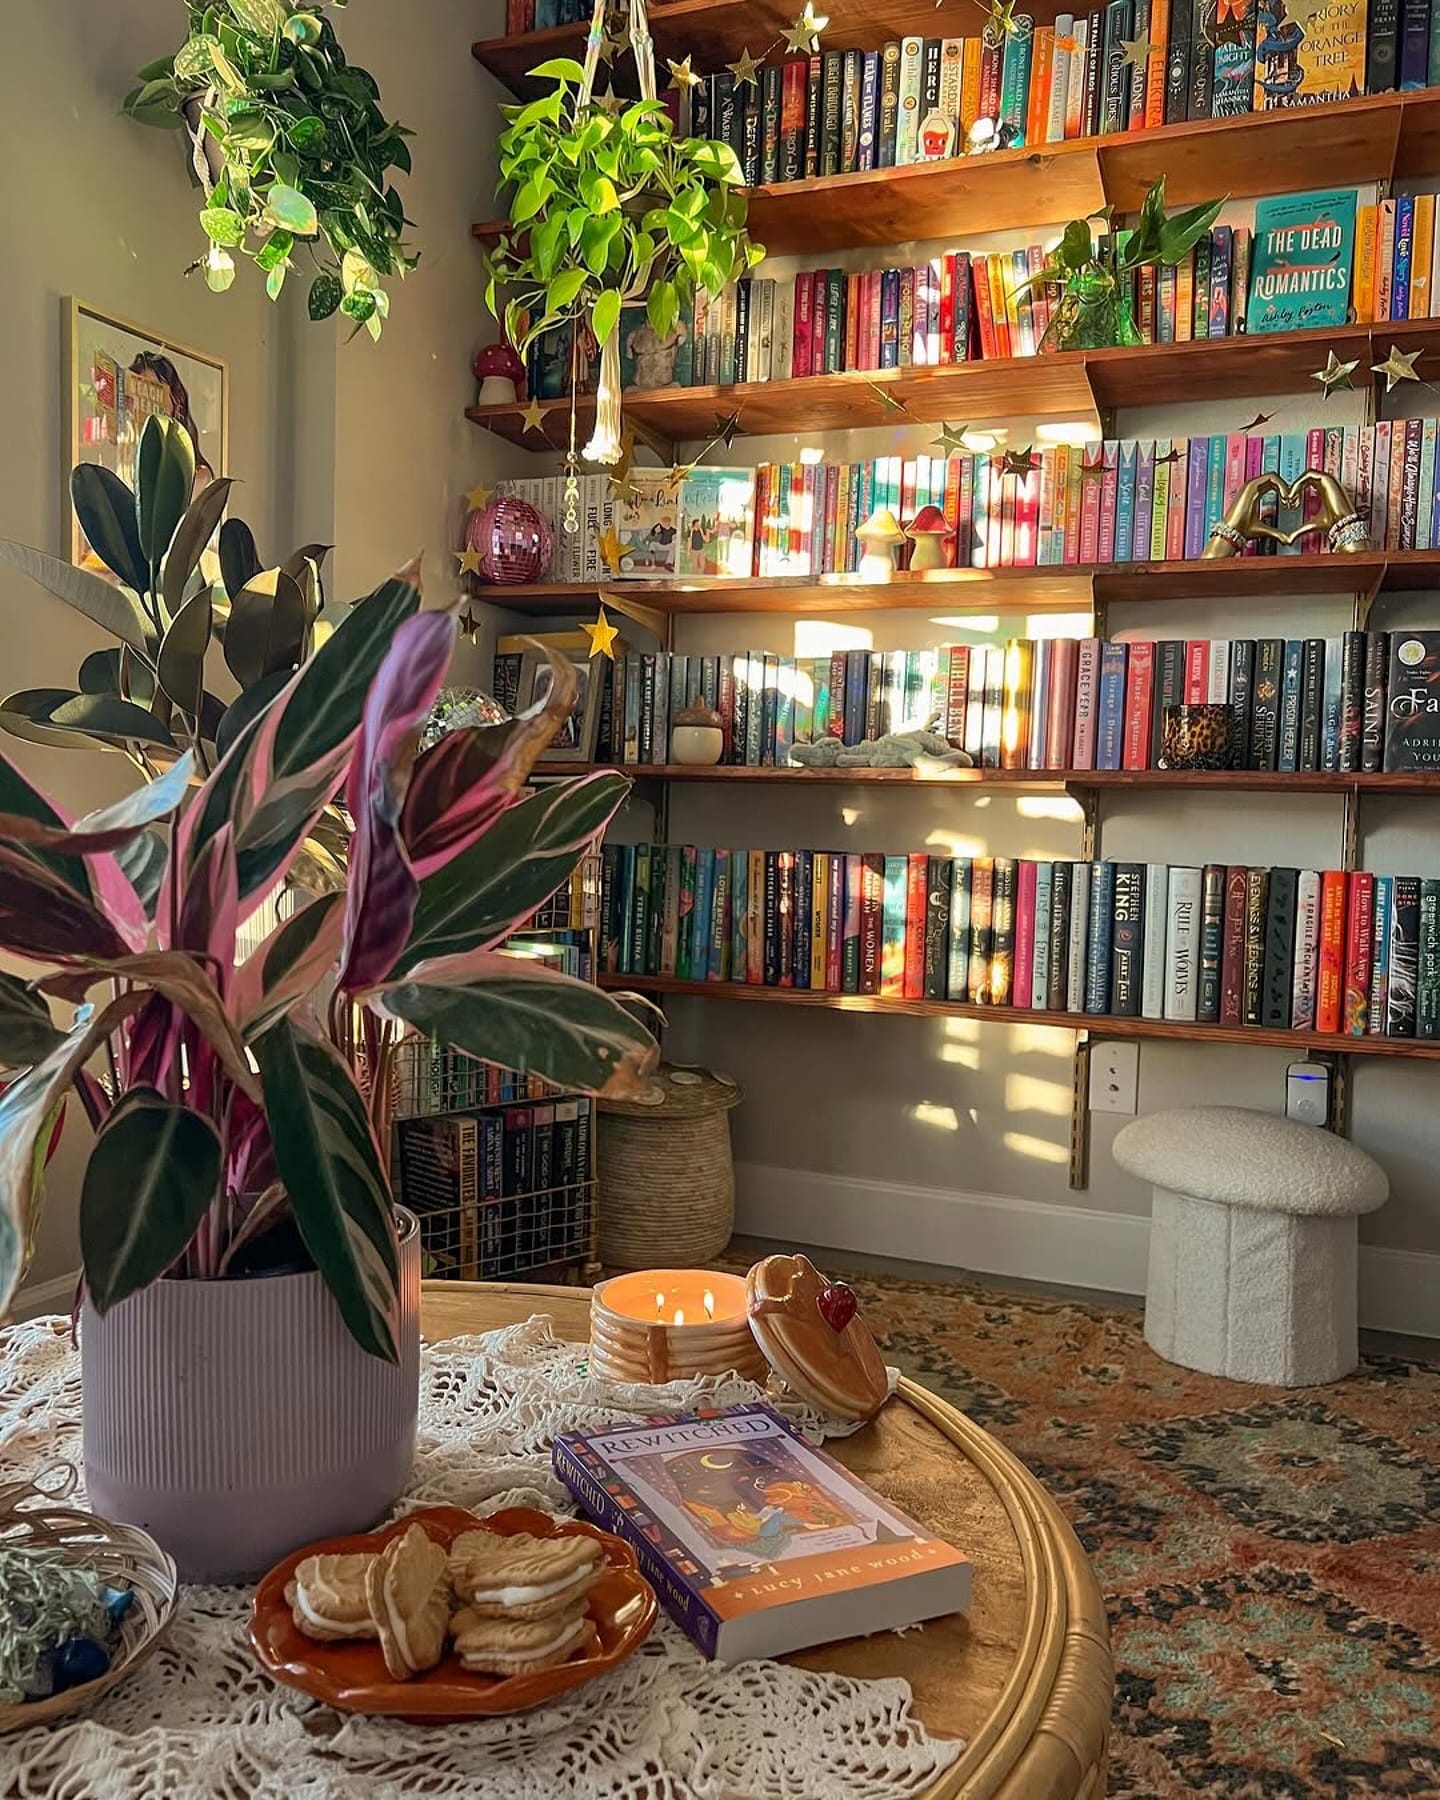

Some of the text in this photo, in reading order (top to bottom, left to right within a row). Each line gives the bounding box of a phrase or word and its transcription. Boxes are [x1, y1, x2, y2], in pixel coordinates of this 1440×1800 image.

[1090, 31, 1099, 57] PALACE
[1301, 31, 1364, 53] ORANGE
[827, 58, 840, 83] LEIGH
[883, 46, 899, 90] Divine
[1090, 60, 1096, 69] OF
[1314, 51, 1349, 67] TREE
[862, 60, 876, 129] FEAR FLAMES
[947, 64, 960, 118] STARDUST
[1015, 72, 1025, 100] SHARD
[1107, 52, 1124, 122] CURIOUS TIDES
[1150, 60, 1165, 127] ELEKTRA
[1282, 90, 1350, 108] SAMANTHA
[810, 94, 818, 125] WISHING
[825, 87, 839, 130] BARDUGO
[746, 116, 758, 147] DEFY
[1267, 226, 1342, 255] THE DEAD
[1400, 213, 1411, 237] Novel
[1397, 238, 1410, 257] Love
[902, 283, 912, 319] FORGET
[1311, 431, 1320, 452] Some
[1120, 483, 1133, 505] Score
[1154, 479, 1168, 506] Legacy
[1118, 528, 1127, 557] KENNEDY
[586, 550, 597, 572] FIRE
[1080, 652, 1093, 688] GRACE
[1375, 641, 1384, 679] ADRIENNE
[1079, 692, 1091, 718] YEAR
[1105, 674, 1118, 759] Strange Dreamer
[1234, 692, 1246, 723] DARK
[1363, 688, 1382, 747] SAINT
[1391, 688, 1440, 720] Fa
[947, 708, 963, 740] BENT
[1131, 711, 1142, 760] Nightmares
[1253, 705, 1268, 758] SERPENT
[1264, 711, 1277, 753] GILDED
[1283, 695, 1298, 761] PRISON HEALER
[831, 896, 840, 918] cursed
[1053, 872, 1064, 932] HIS HERS
[1114, 873, 1130, 922] KING
[1129, 873, 1141, 922] STEPHEN
[1335, 885, 1343, 907] ANITA
[1376, 882, 1386, 905] JENNY
[634, 896, 644, 961] YERBA BUENA
[714, 875, 727, 949] LOVERS AND LIARS
[1304, 903, 1314, 939] FRAGILE
[1375, 907, 1385, 941] JACKSON
[1248, 875, 1262, 989] EVENINGS & WEEKENDS
[1324, 922, 1332, 941] LAST
[1355, 890, 1372, 984] How to Walk Away
[1426, 895, 1438, 977] greenwich park
[865, 930, 876, 972] WOMEN
[1174, 902, 1193, 995] RULE WOLVES
[1116, 979, 1130, 1001] TALE
[462, 1125, 476, 1145] THE
[600, 1418, 772, 1455] REWITCHED
[556, 1449, 606, 1515] REWITCHED
[868, 1549, 924, 1571] wood
[666, 1580, 691, 1611] wood
